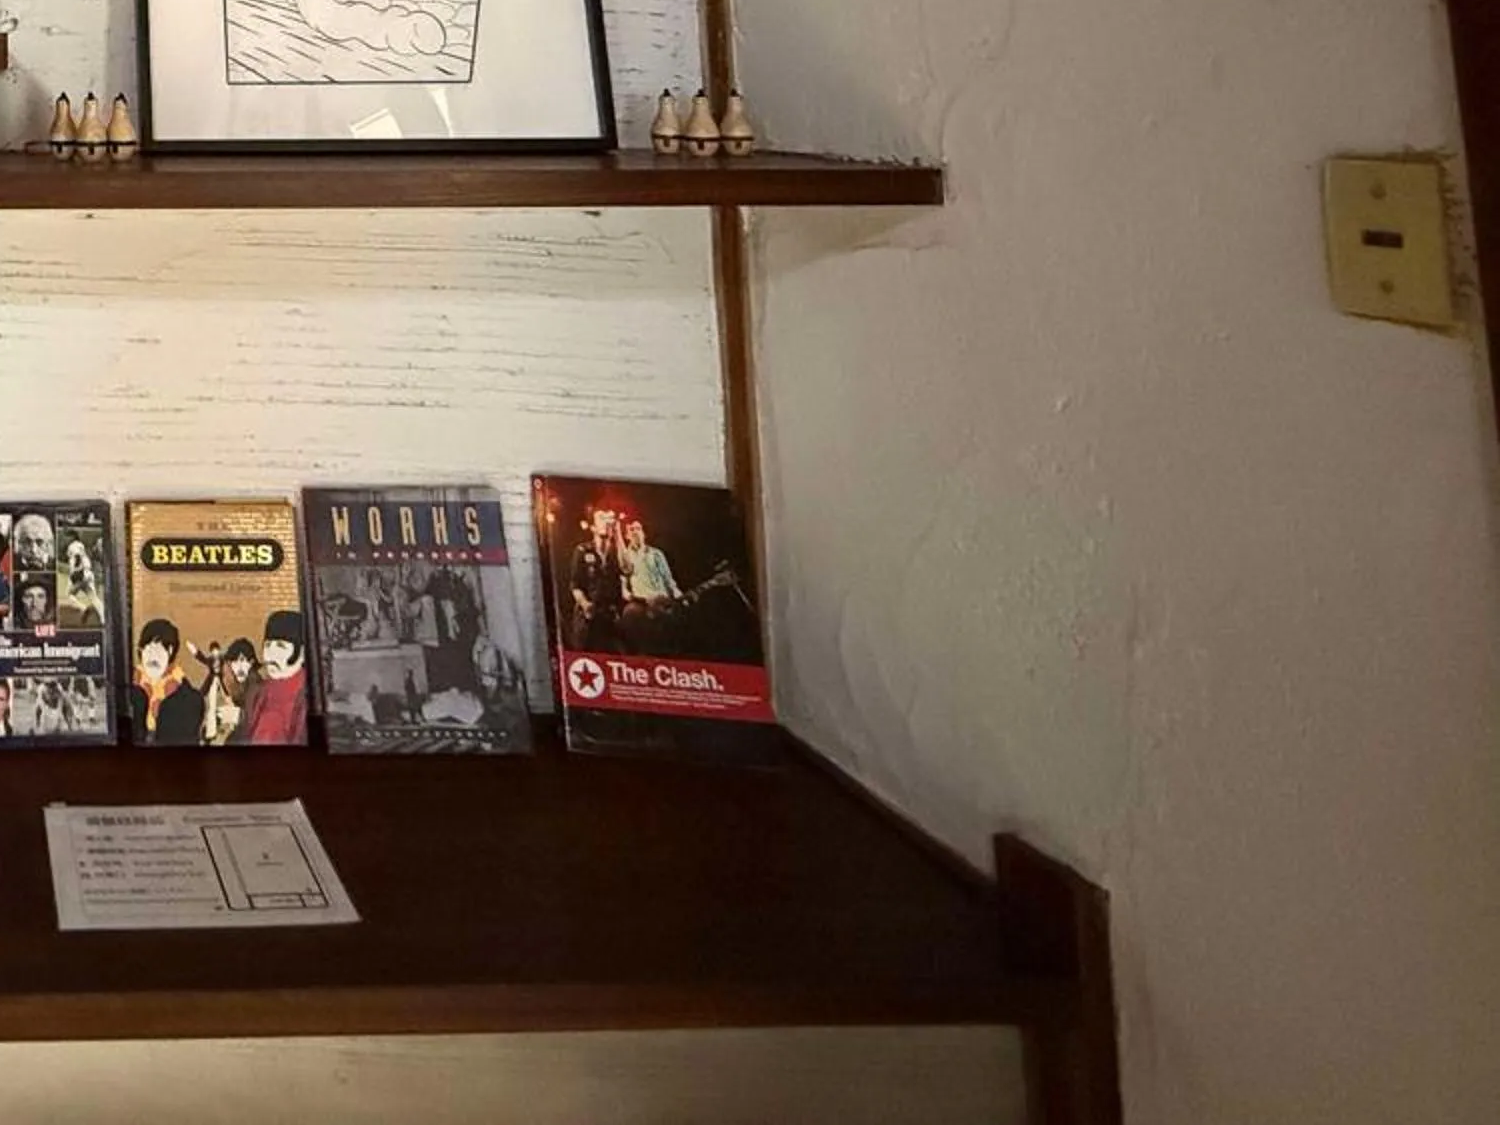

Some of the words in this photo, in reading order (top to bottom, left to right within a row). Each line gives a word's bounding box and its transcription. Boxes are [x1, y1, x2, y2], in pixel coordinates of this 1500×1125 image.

[151, 544, 274, 565] BEATLES
[606, 660, 648, 684] The
[655, 665, 724, 692] Clash.
